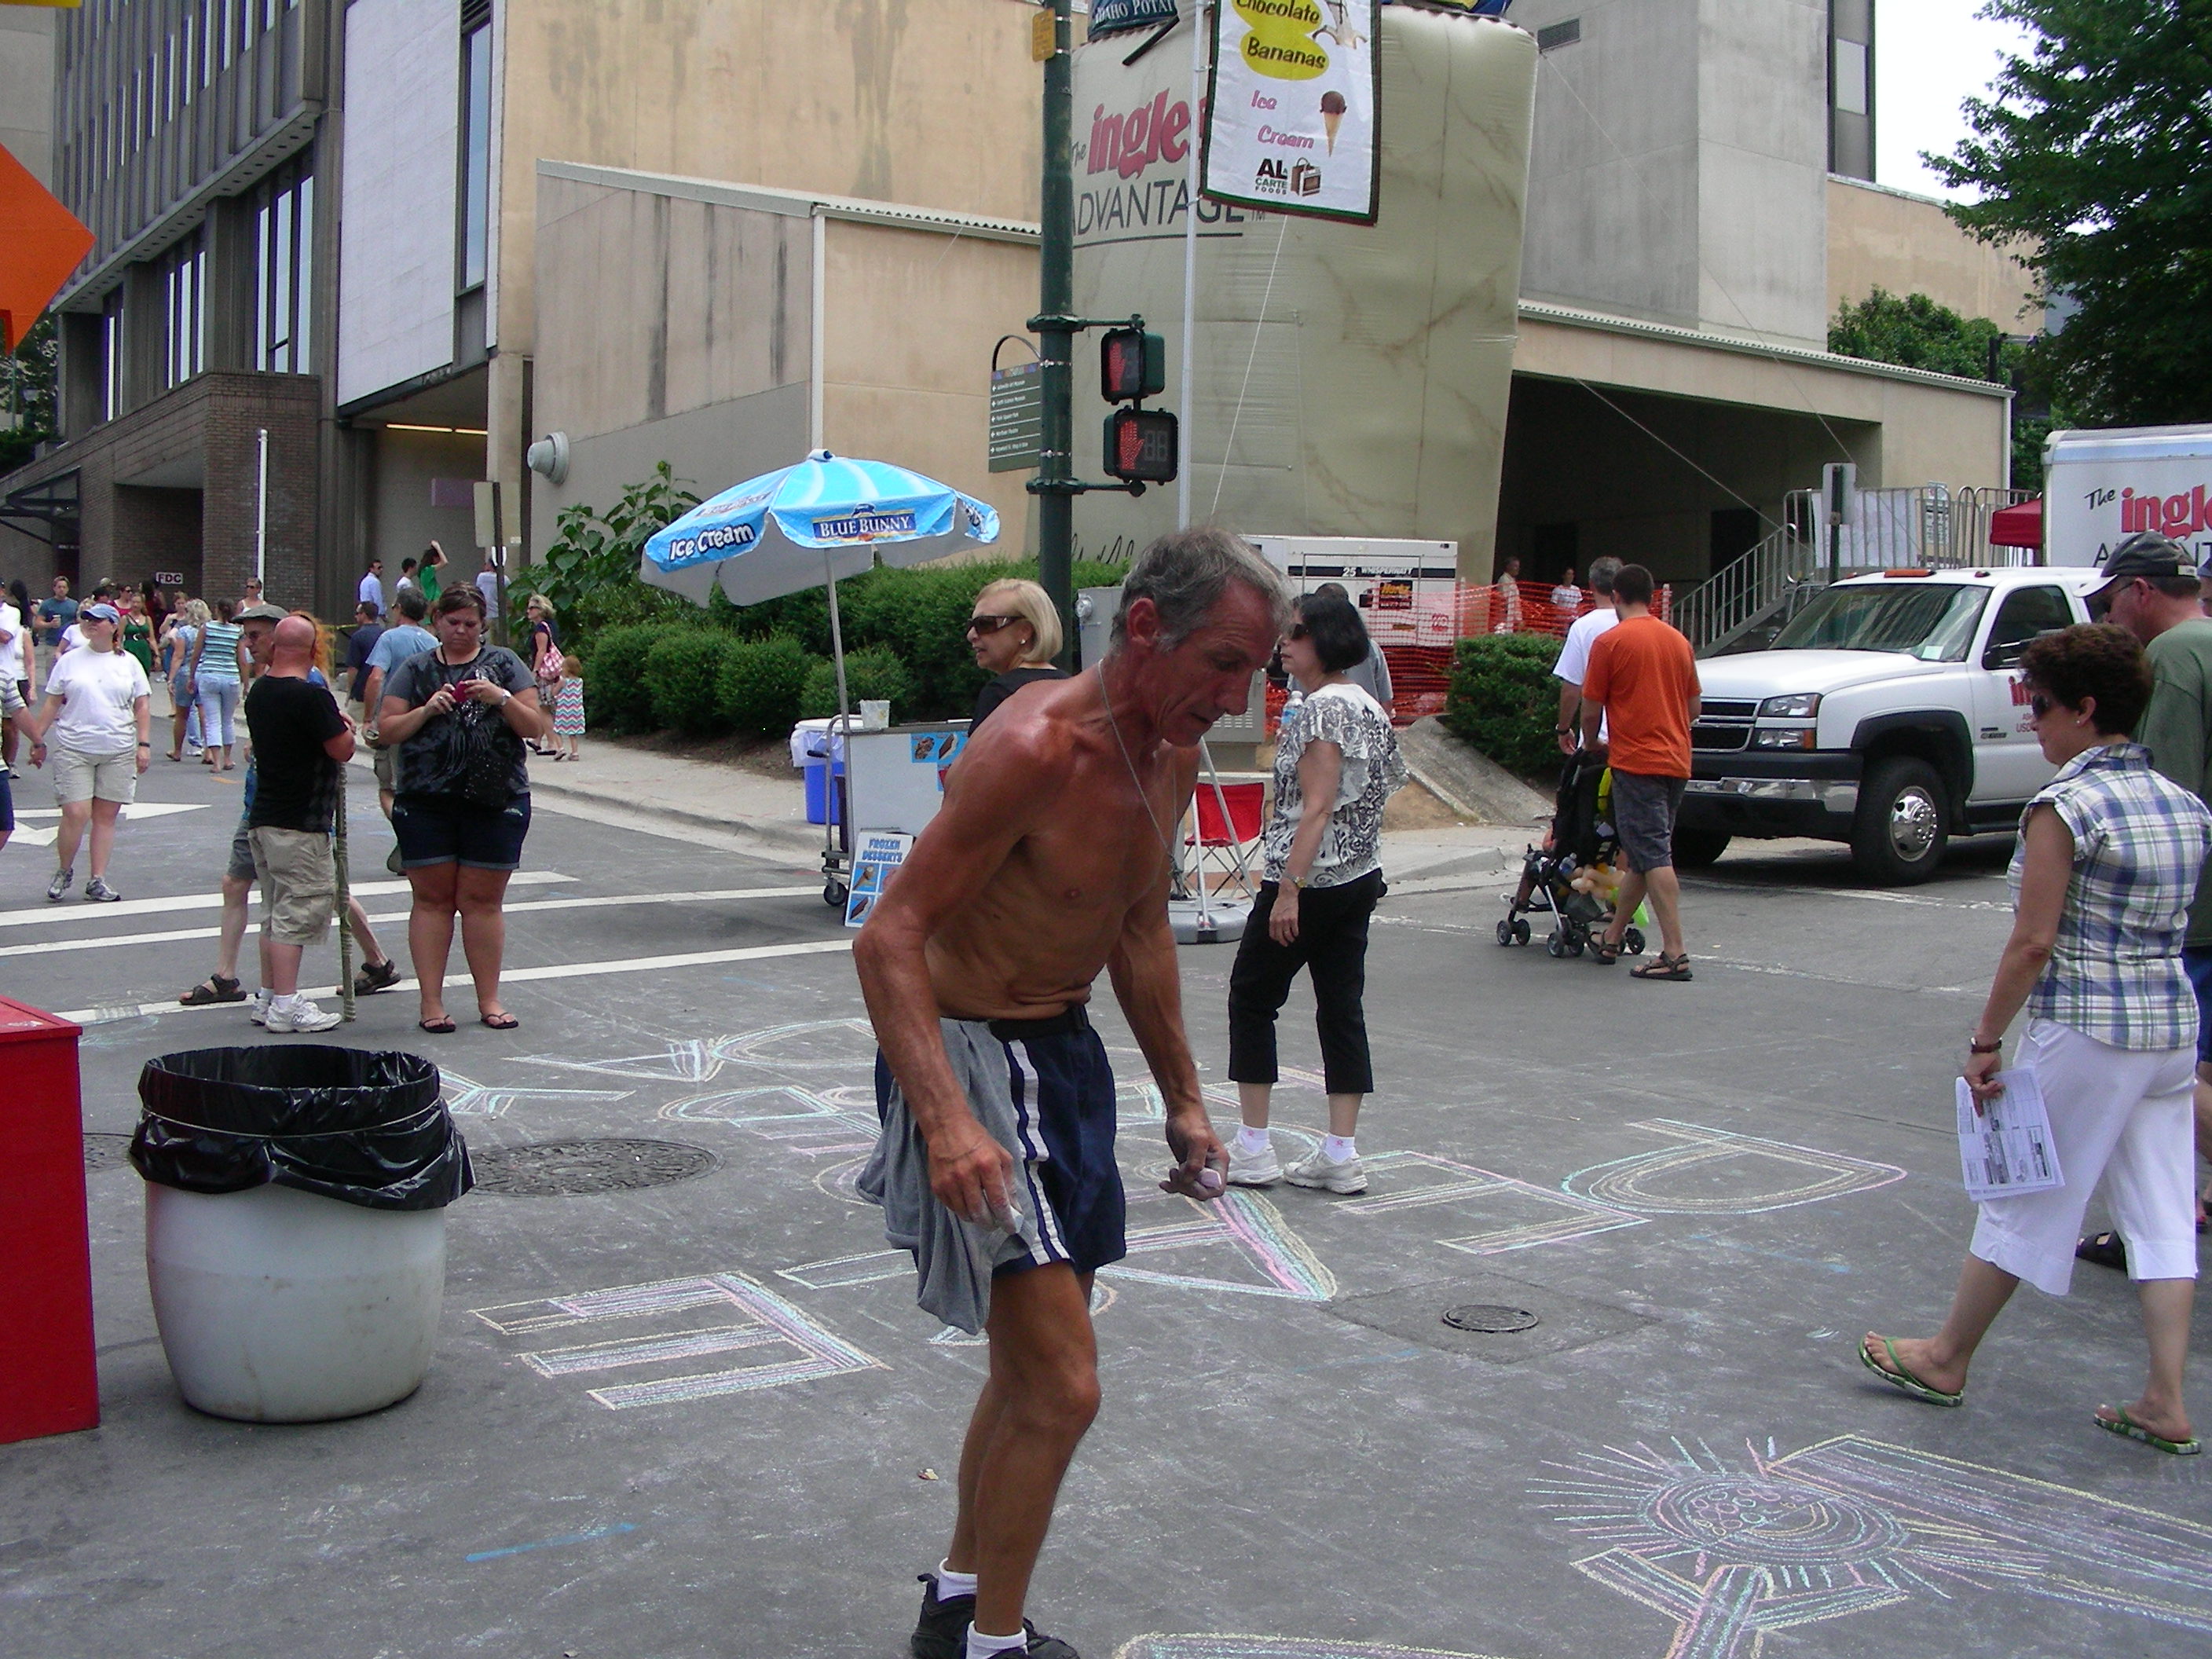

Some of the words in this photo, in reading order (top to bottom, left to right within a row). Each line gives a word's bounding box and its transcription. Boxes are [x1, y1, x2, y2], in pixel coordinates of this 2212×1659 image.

[1247, 36, 1326, 69] Bananas
[1251, 90, 1277, 110] Ice
[1087, 88, 1207, 180] ingle
[1257, 125, 1314, 148] Cream
[1257, 159, 1287, 180] AL
[1255, 178, 1287, 189] CARTE
[1255, 186, 1287, 195] FOODS
[1073, 179, 1244, 236] DVANTAG
[2084, 488, 2115, 510] The
[2122, 484, 2212, 540] ingl
[820, 519, 857, 538] BLUE
[859, 515, 910, 533] BUNNY
[669, 537, 695, 561] Ice
[697, 524, 755, 553] Cream
[158, 573, 181, 583] FDC
[1342, 567, 1357, 577] 25
[868, 838, 900, 850] FROZEN
[862, 851, 903, 862] DESSERTS
